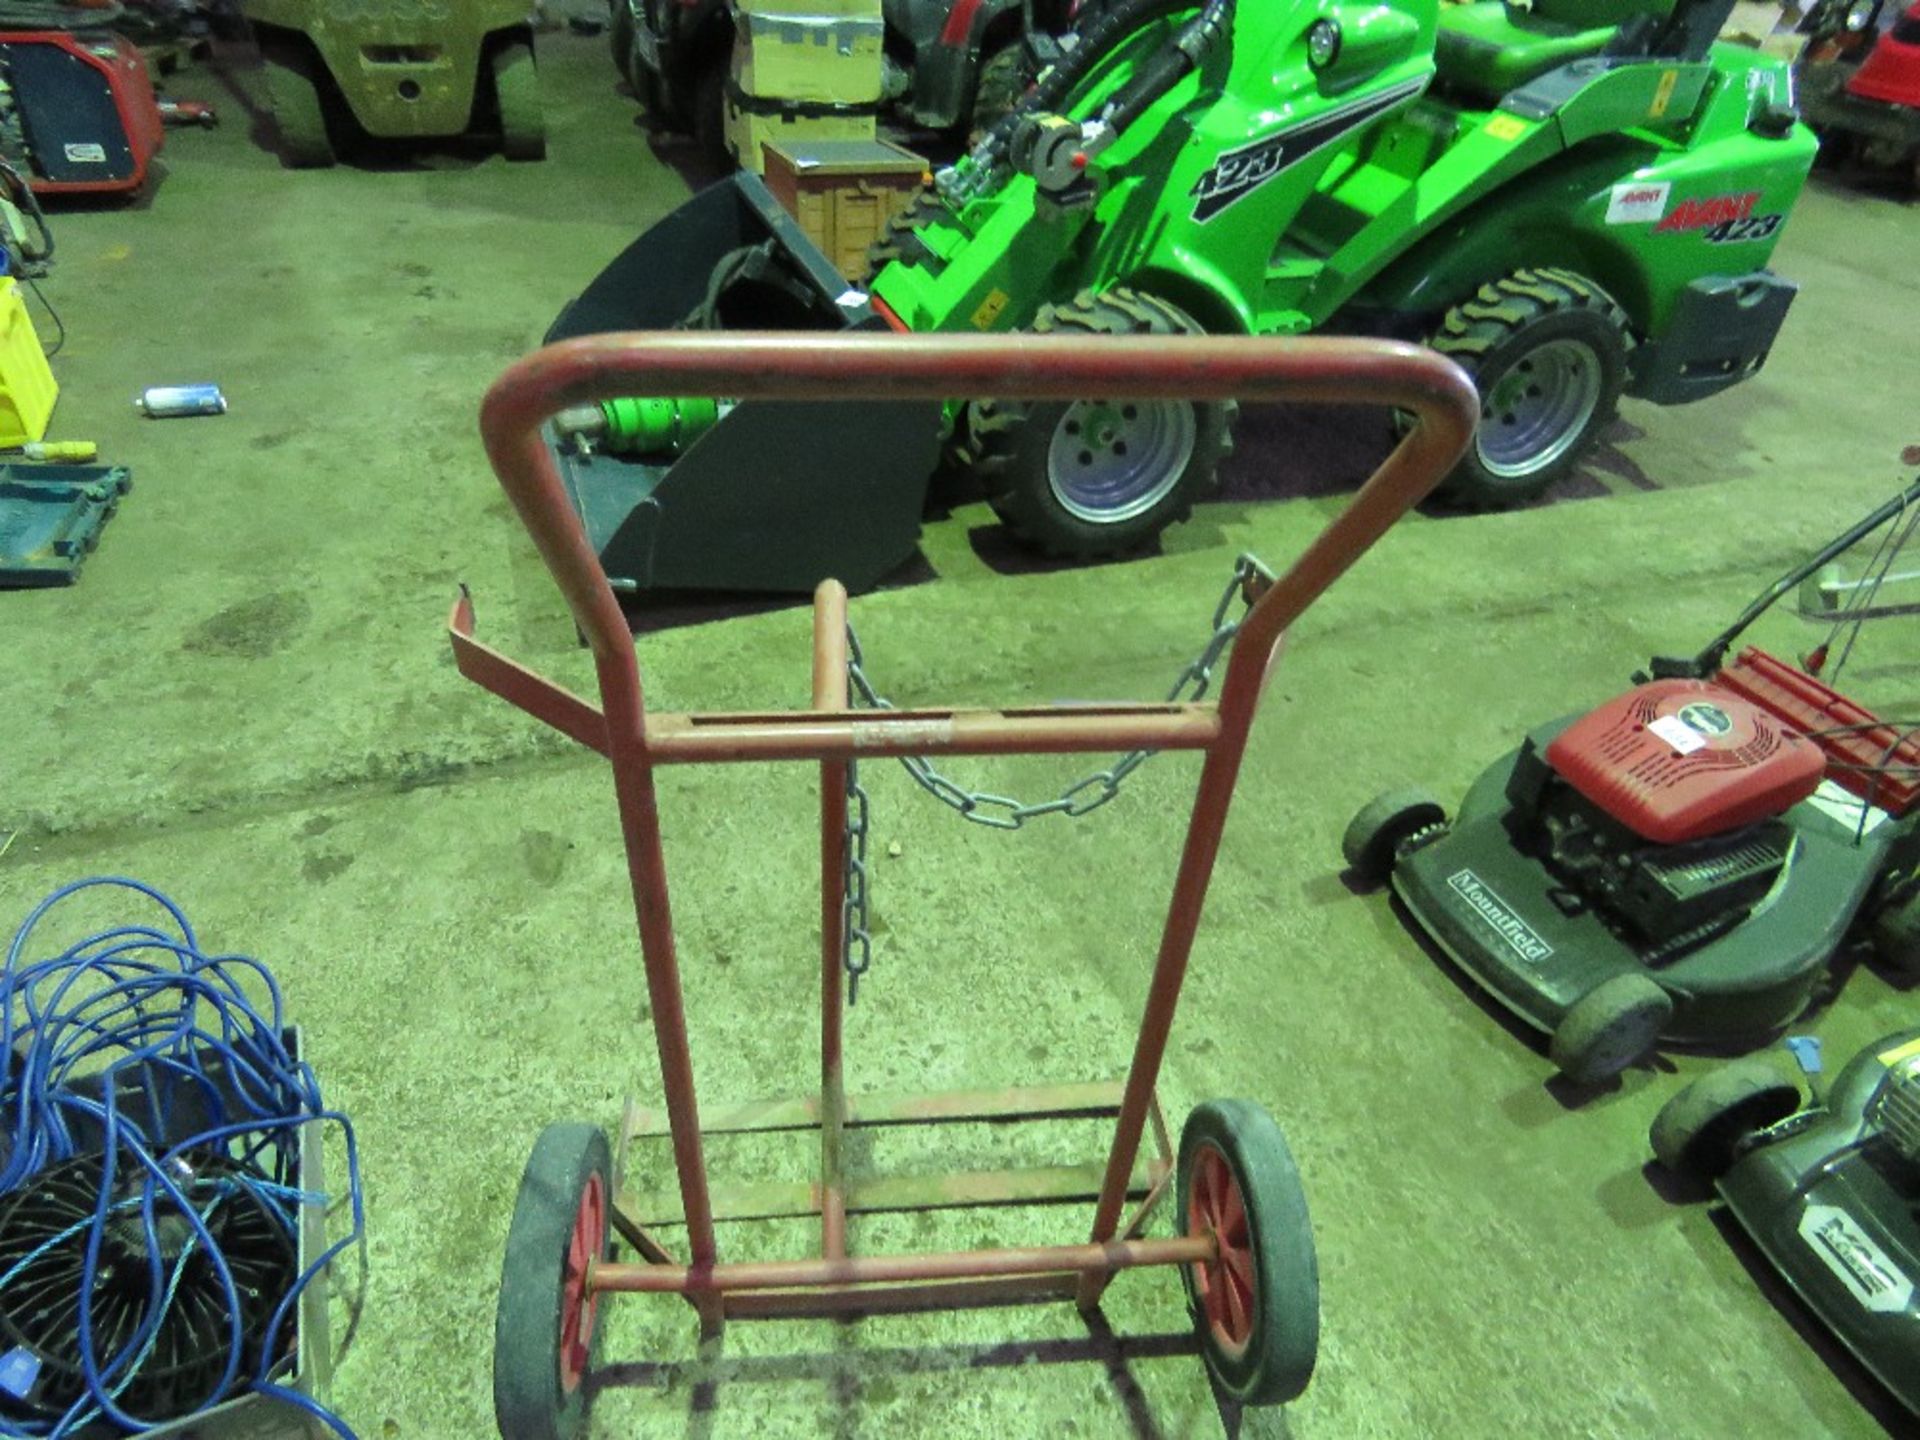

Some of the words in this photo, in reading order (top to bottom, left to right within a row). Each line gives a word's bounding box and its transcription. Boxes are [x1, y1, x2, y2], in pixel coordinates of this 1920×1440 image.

[1653, 190, 1762, 233] AVANT
[1703, 214, 1784, 244] 423
[1453, 874, 1547, 960] Mountfield
